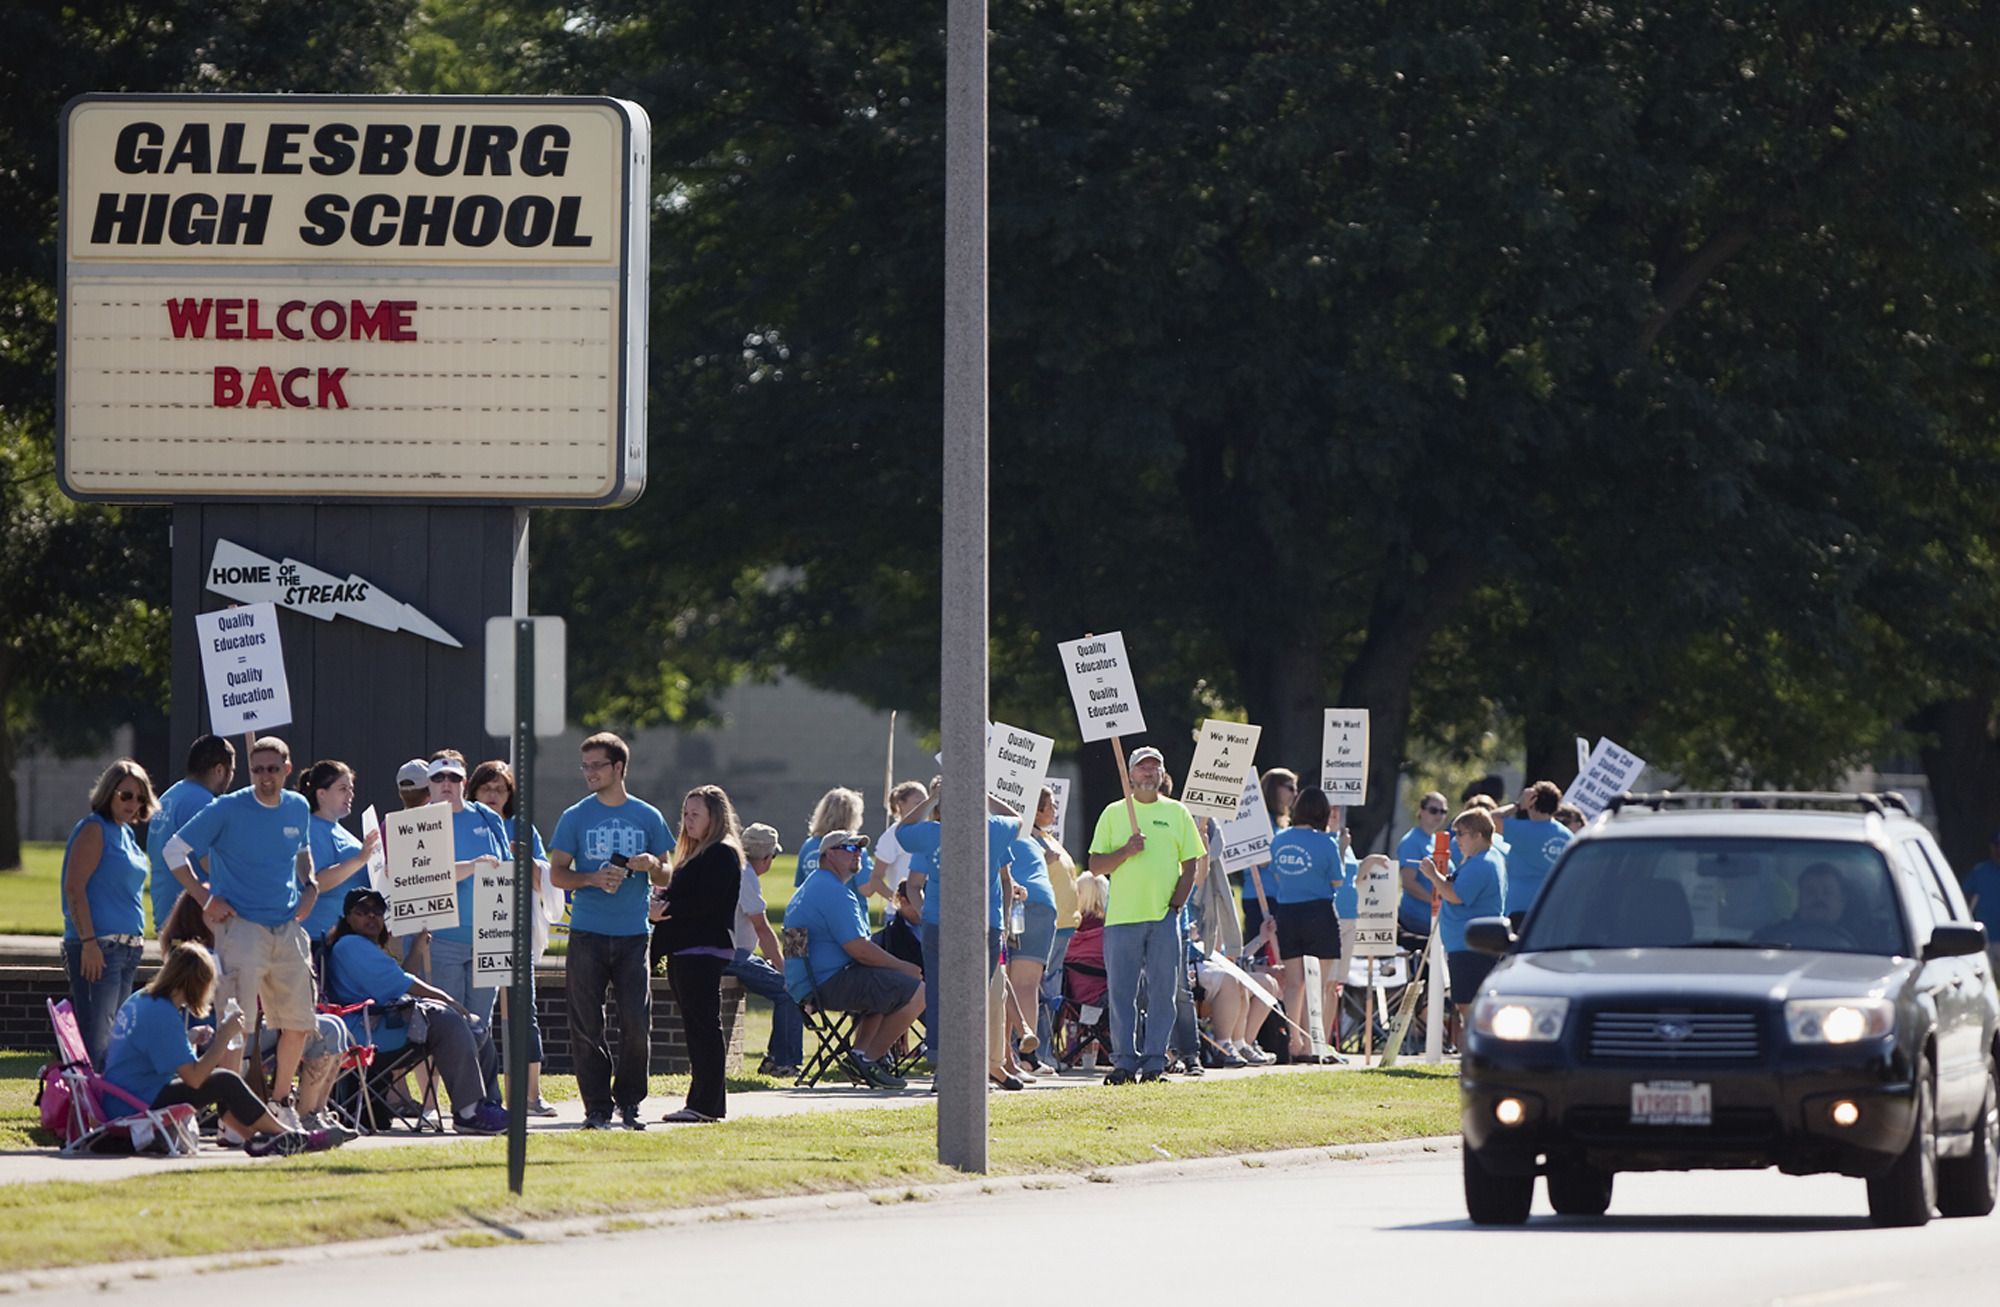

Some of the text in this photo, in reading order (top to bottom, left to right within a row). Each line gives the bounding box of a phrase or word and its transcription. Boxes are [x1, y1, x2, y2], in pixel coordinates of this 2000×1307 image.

[114, 122, 571, 177] GALESBURG
[91, 193, 593, 247] HIGH SCHOOL
[167, 298, 417, 341] WELCOME
[213, 366, 349, 408] BACK
[213, 566, 270, 584] HOME
[279, 565, 296, 576] OF
[276, 576, 300, 586] THE
[284, 583, 369, 605] STREAKS
[218, 613, 254, 632] Quality
[214, 633, 266, 653] Educators
[1077, 642, 1106, 657] Quality
[1075, 658, 1118, 674] Educators
[227, 668, 262, 687] Quality
[222, 687, 274, 708] Education
[1089, 687, 1118, 702] Quality
[1087, 702, 1129, 718] Education
[1331, 720, 1360, 728] We Want
[1007, 733, 1035, 753] Quality
[1210, 732, 1249, 745] We Want
[1343, 733, 1348, 741] A
[998, 747, 1037, 769] Educators
[1221, 747, 1229, 755] A
[1338, 746, 1351, 755] Fair
[1213, 759, 1230, 768] Fair
[1326, 759, 1362, 768] Settlement
[1193, 770, 1244, 785] Settlement
[996, 777, 1024, 797] Quality
[1324, 781, 1337, 791] IEA
[1345, 781, 1361, 791] NEA
[1186, 791, 1204, 802] IEA
[1214, 795, 1237, 806] NEA
[398, 820, 442, 836] We Want
[417, 839, 425, 850] A
[1223, 848, 1240, 859] IEA
[1248, 838, 1270, 852] NEA
[412, 856, 431, 868] Fair
[1279, 854, 1305, 866] GEA
[394, 870, 451, 888] Settlement
[482, 876, 515, 887] We Wan
[1369, 872, 1389, 880] Want
[1369, 885, 1375, 893] A
[496, 893, 504, 904] A
[1365, 898, 1379, 906] Fair
[394, 904, 415, 917] IEA
[428, 897, 454, 912] NEA
[492, 910, 508, 921] Fair
[1357, 911, 1393, 919] ettlement
[1355, 932, 1366, 941] EA
[1374, 932, 1393, 941] NEA
[478, 956, 495, 969] IEA
